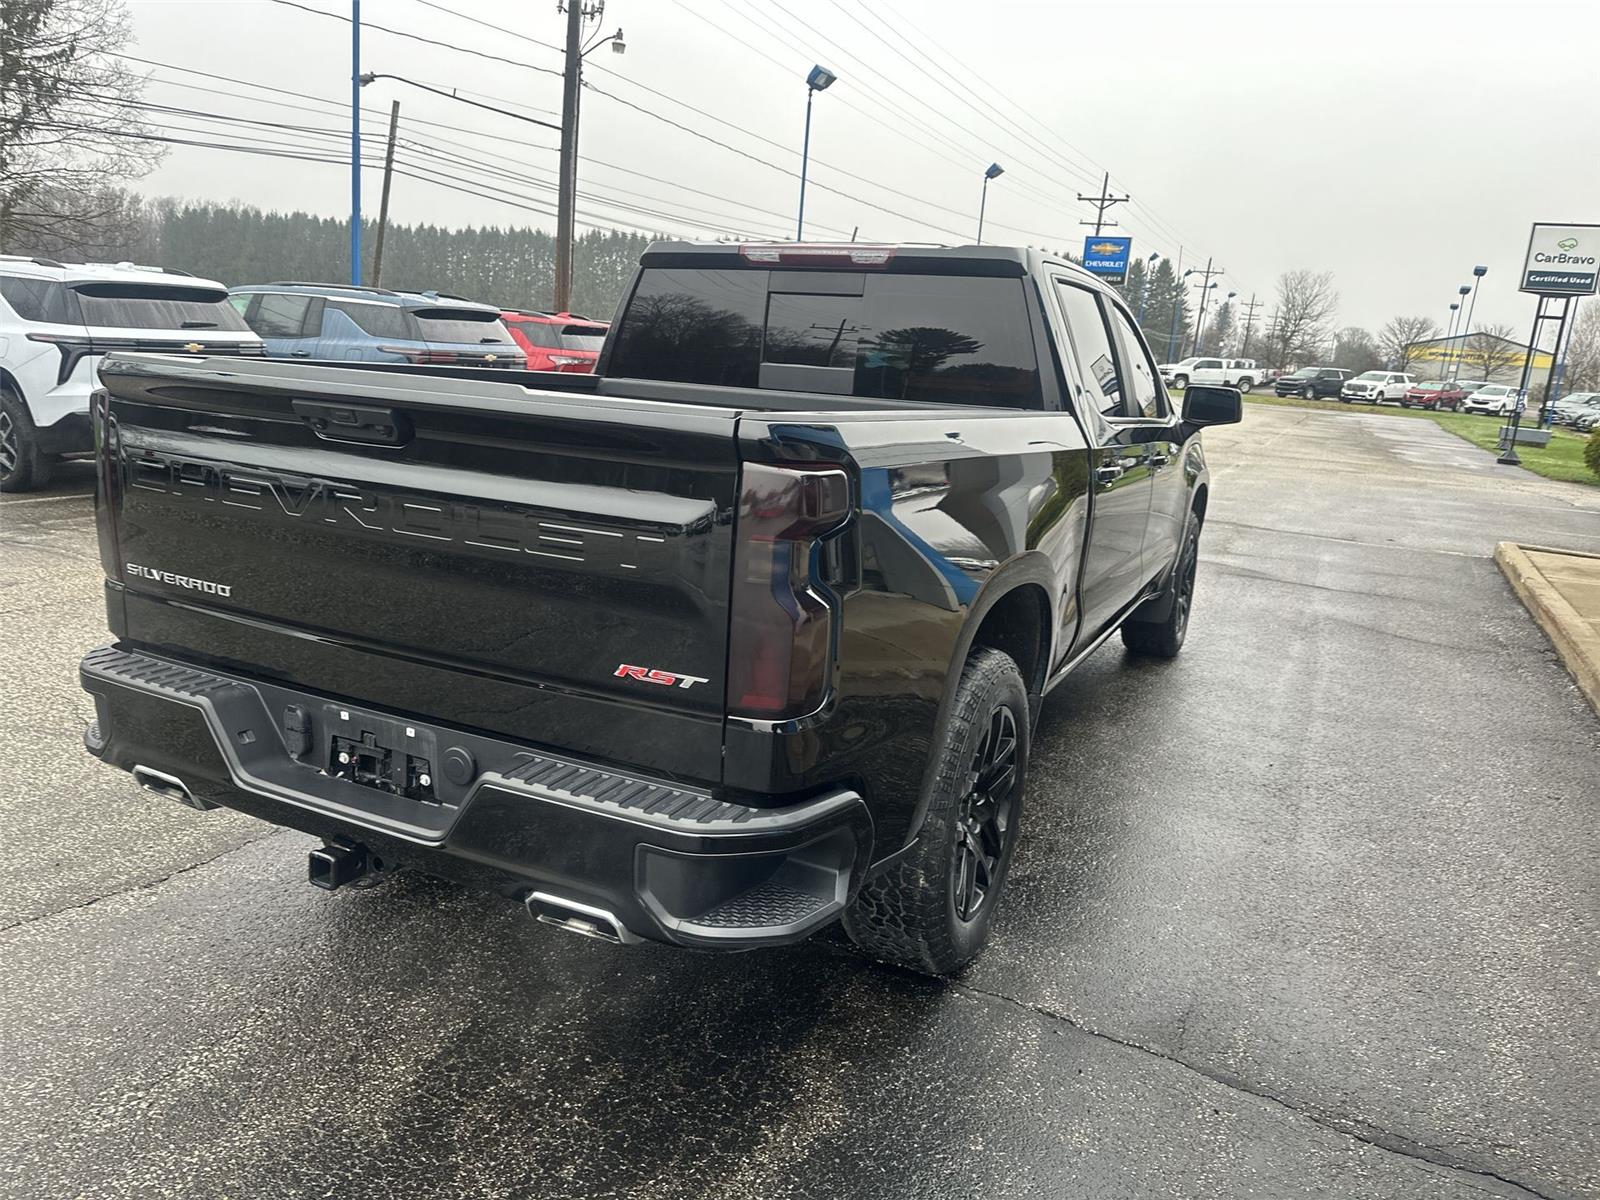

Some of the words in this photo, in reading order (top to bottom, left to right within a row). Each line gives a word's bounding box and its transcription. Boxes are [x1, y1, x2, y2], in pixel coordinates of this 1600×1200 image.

[1085, 260, 1124, 268] CHEVROLET
[1534, 252, 1595, 265] CarBravo
[1529, 275, 1568, 283] Certified
[126, 562, 232, 598] SILVERADO
[613, 663, 710, 689] RST
